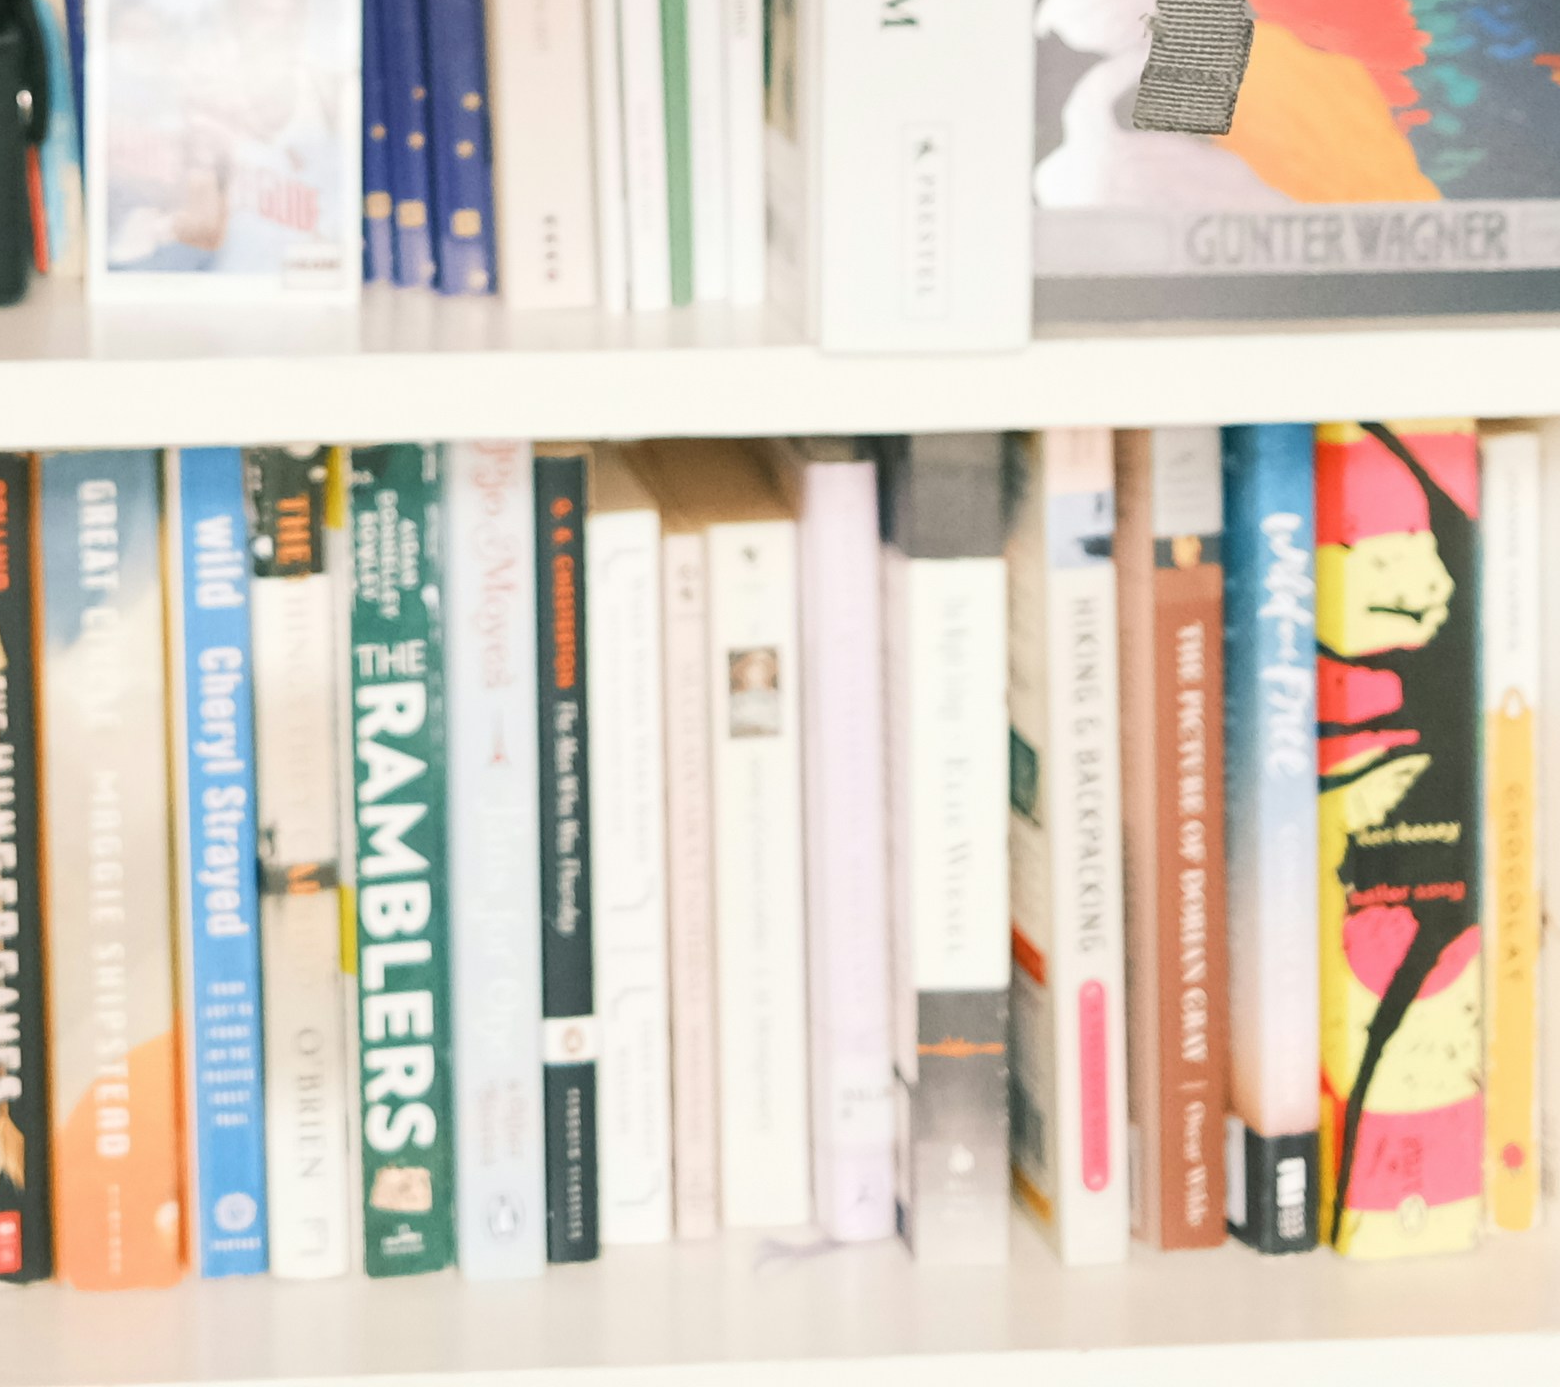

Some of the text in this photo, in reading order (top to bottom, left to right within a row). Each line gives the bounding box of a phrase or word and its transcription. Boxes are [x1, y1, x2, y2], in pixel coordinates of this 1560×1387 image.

[79, 481, 117, 592] GREAT
[195, 517, 243, 607] wild
[192, 646, 246, 774] Cheryl
[356, 640, 430, 676] THE
[1072, 598, 1101, 701] HIKING
[201, 786, 248, 936] Strayed
[1075, 750, 1105, 953] BACKPACKING
[89, 771, 130, 1157] MAGGIE SHIPSTEAD
[357, 683, 436, 1153] RAMBLERS
